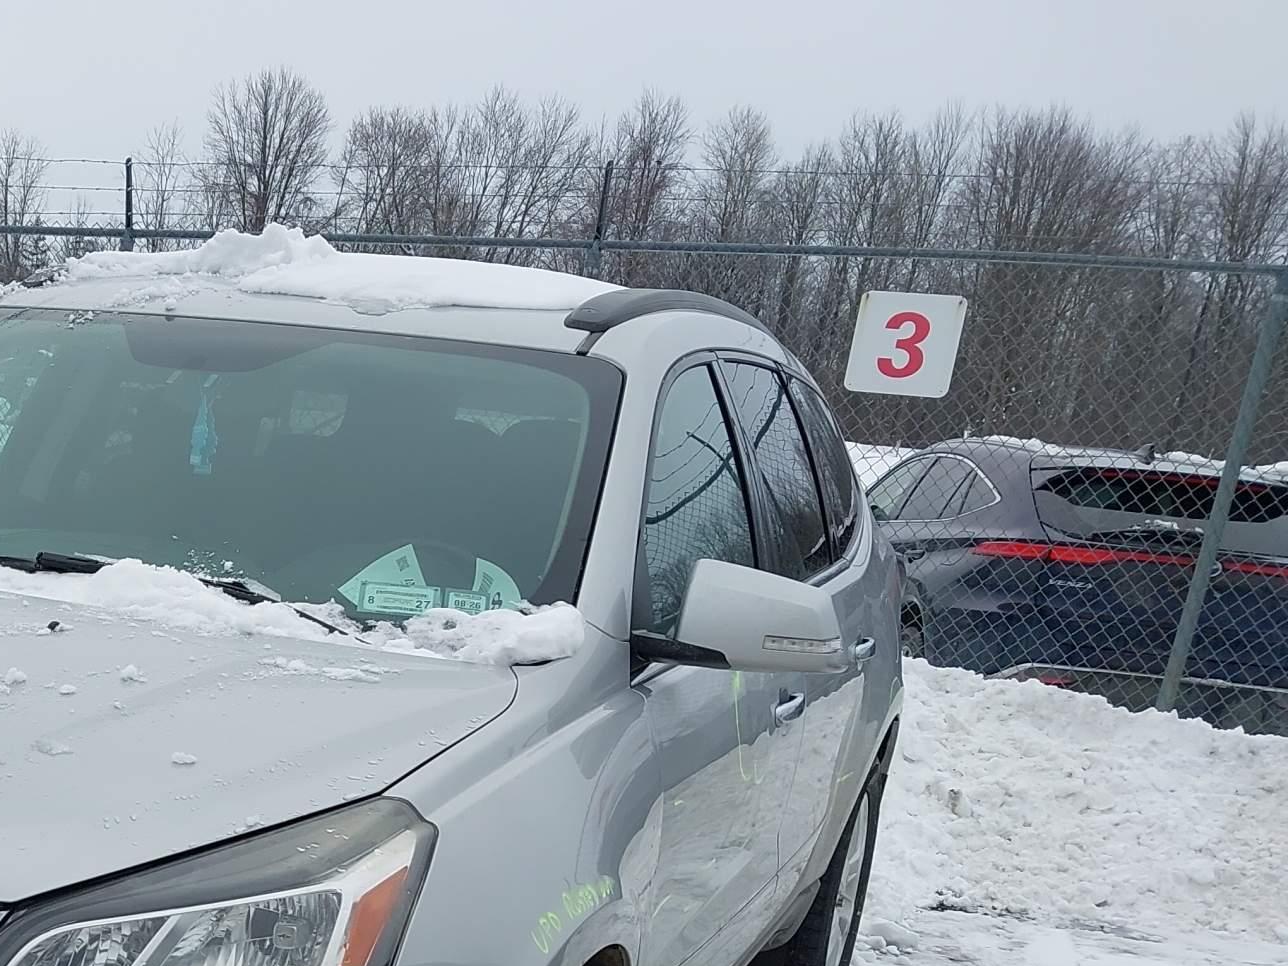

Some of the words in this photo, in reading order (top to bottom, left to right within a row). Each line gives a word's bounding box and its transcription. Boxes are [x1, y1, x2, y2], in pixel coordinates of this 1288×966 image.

[876, 311, 931, 379] 3
[1048, 578, 1092, 589] VENZA
[367, 595, 375, 605] 8
[415, 600, 431, 609] 27
